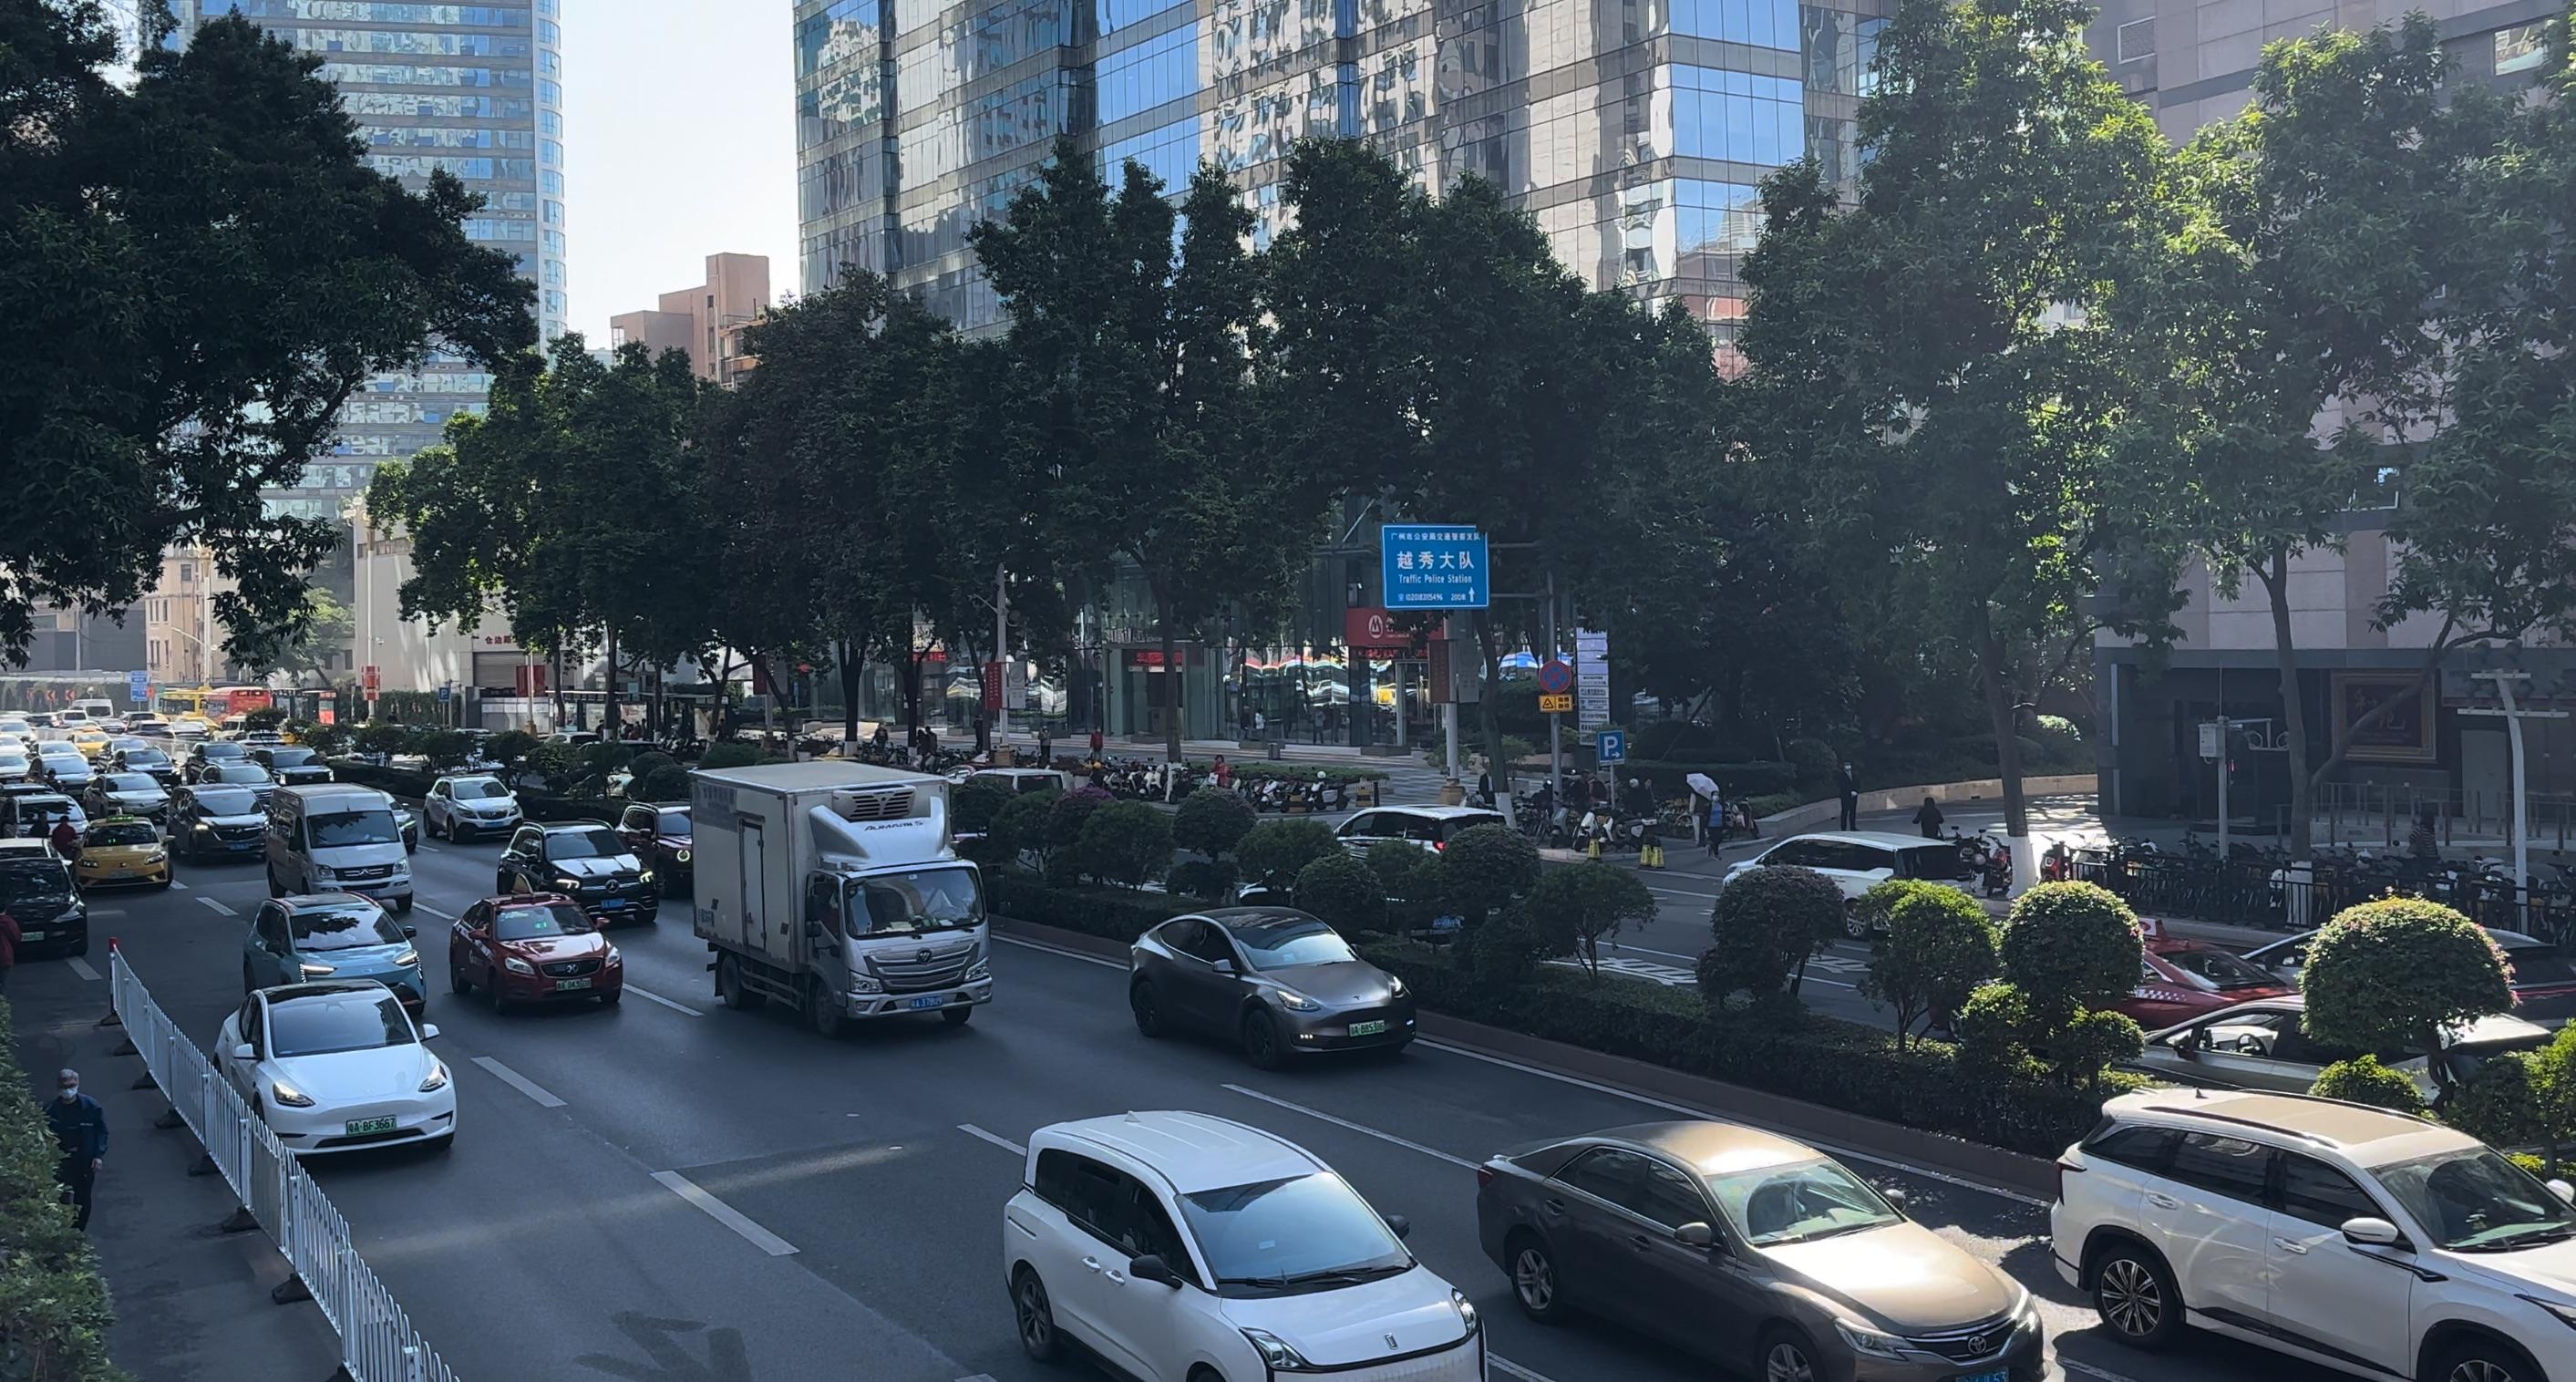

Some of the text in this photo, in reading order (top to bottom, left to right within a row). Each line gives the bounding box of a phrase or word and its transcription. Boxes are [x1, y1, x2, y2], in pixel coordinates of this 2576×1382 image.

[1396, 551, 1475, 570] 越秀大队
[1398, 573, 1472, 584] Traffic Police Station
[1603, 736, 1618, 757] P
